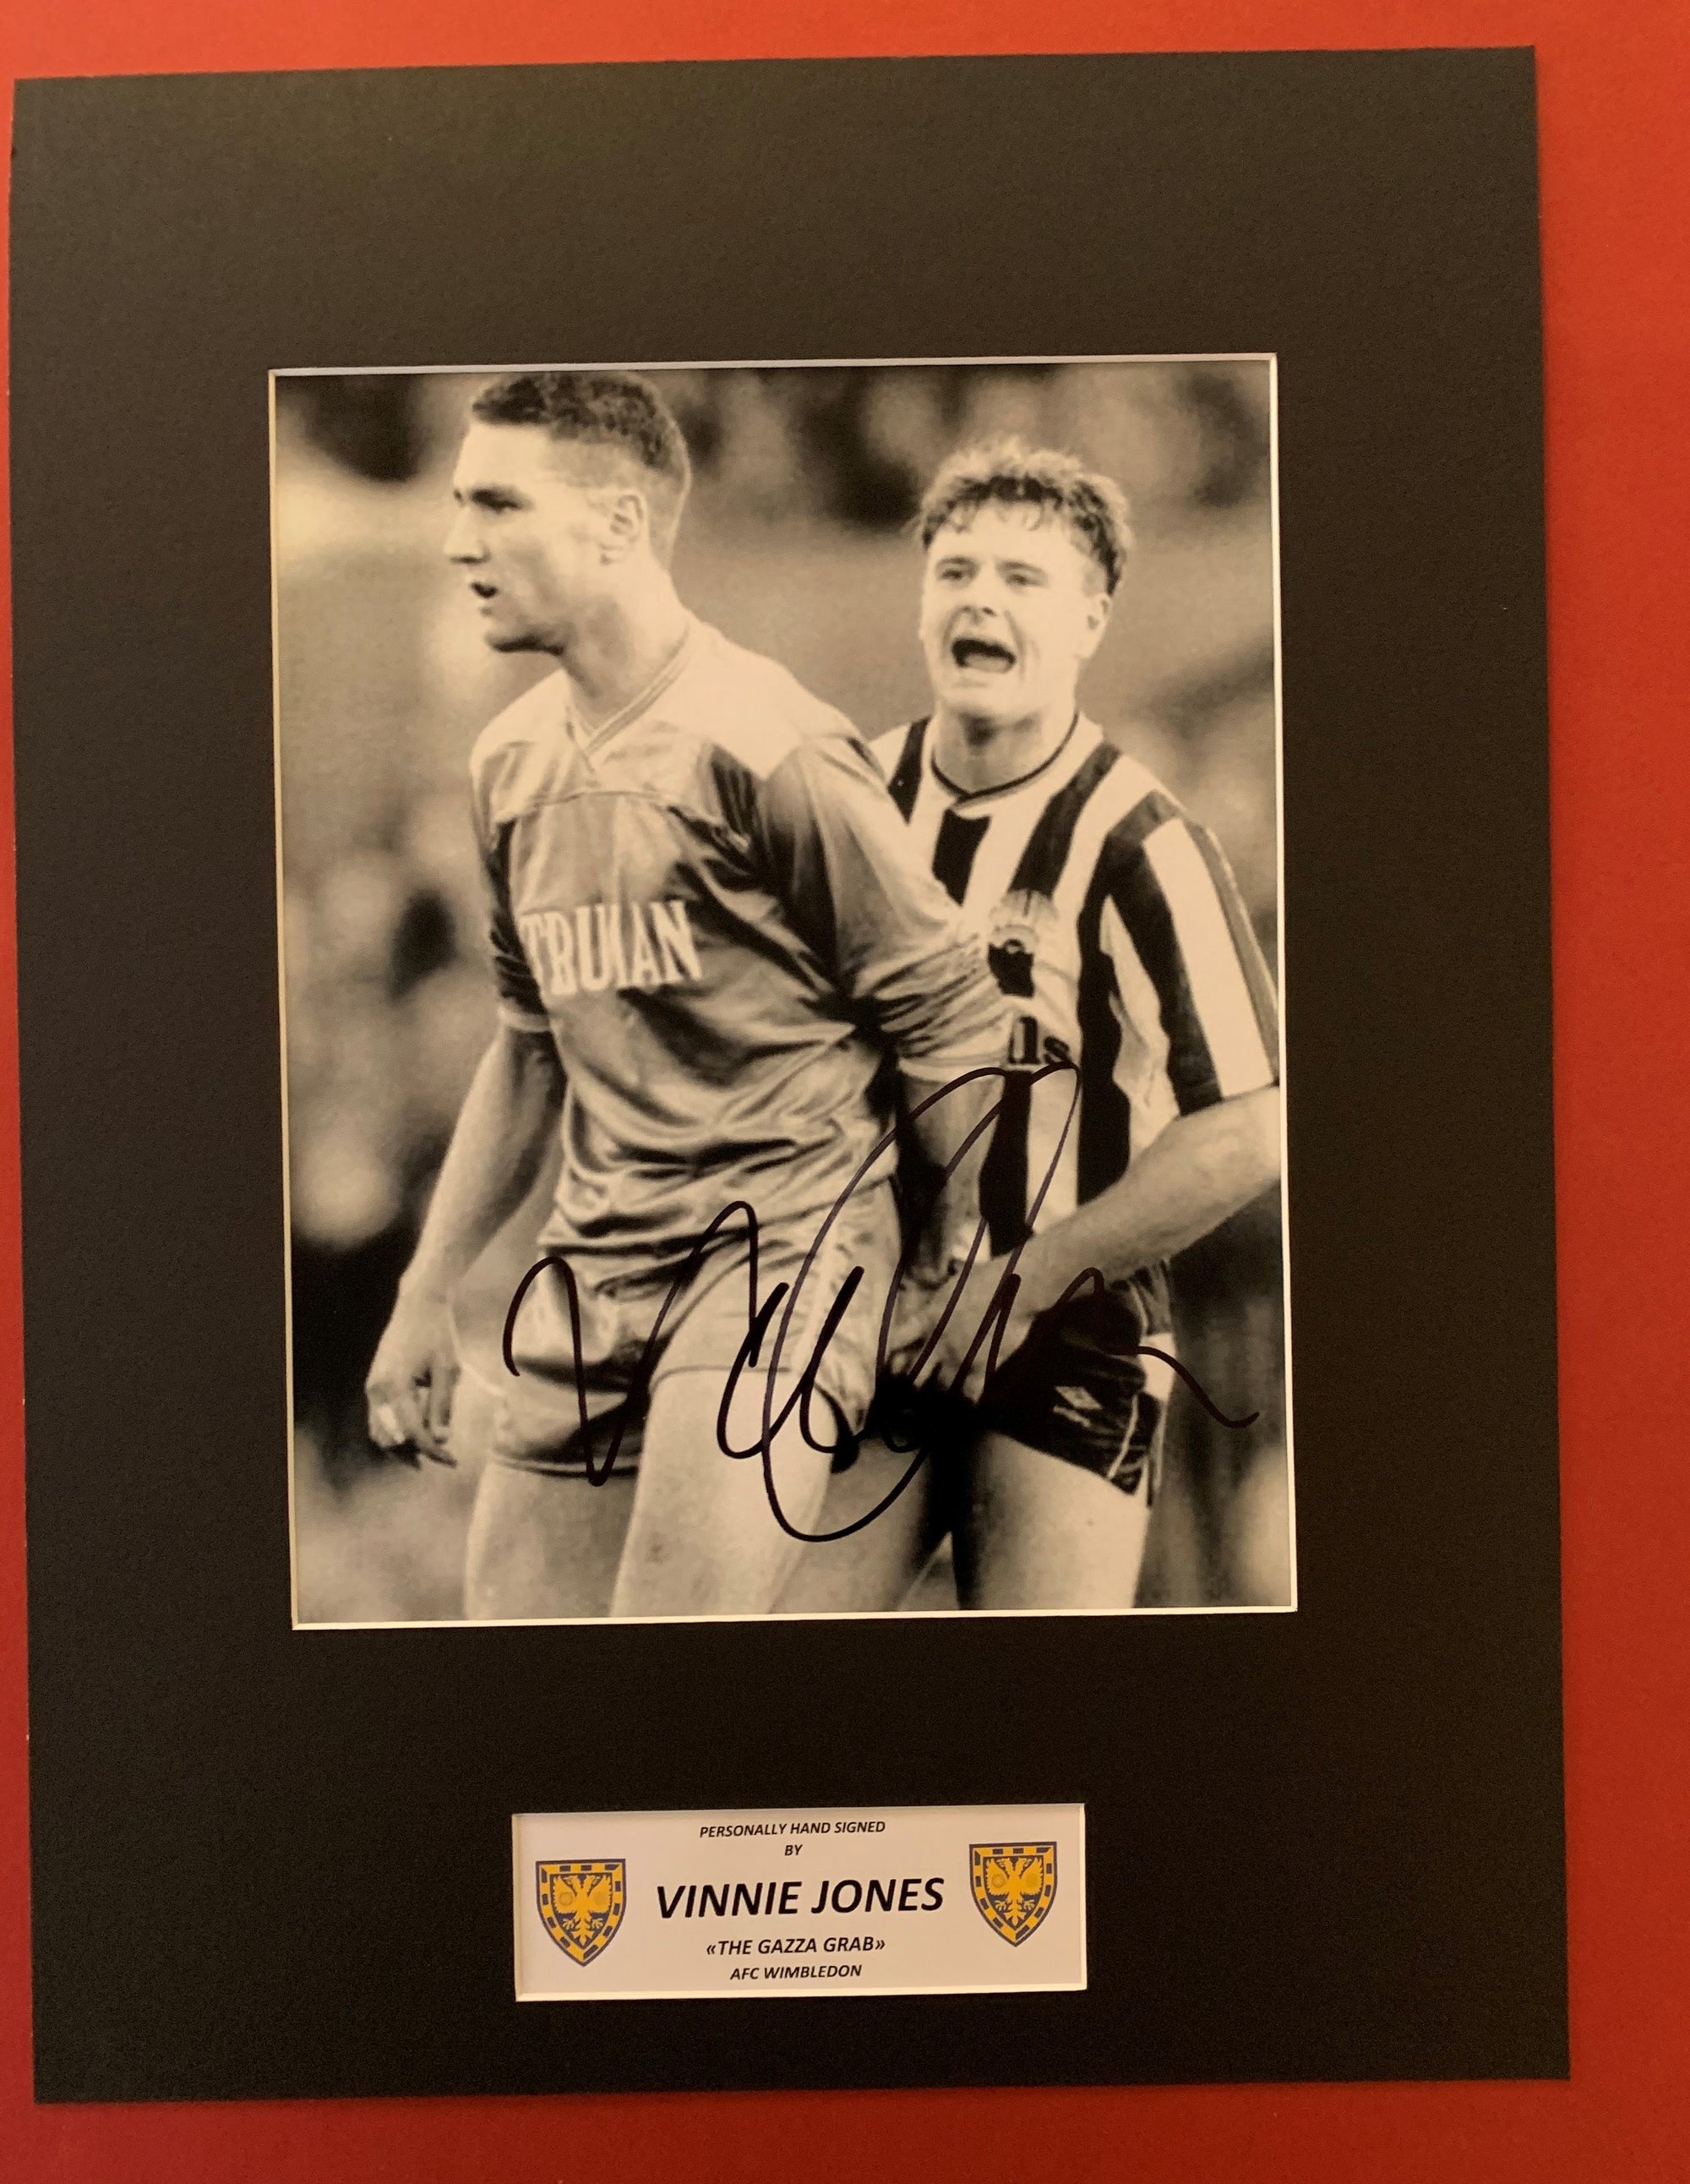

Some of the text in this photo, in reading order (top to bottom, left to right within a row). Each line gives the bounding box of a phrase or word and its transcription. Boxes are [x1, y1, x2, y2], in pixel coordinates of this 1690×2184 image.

[699, 1821, 886, 1838] PERSONALLY HAND SIGNED
[784, 1843, 804, 1856] BY
[657, 1876, 945, 1919] VINNIE JONES
[757, 1937, 817, 1955] GAZZA
[729, 1964, 863, 1980] AFC WIMBLEDON
